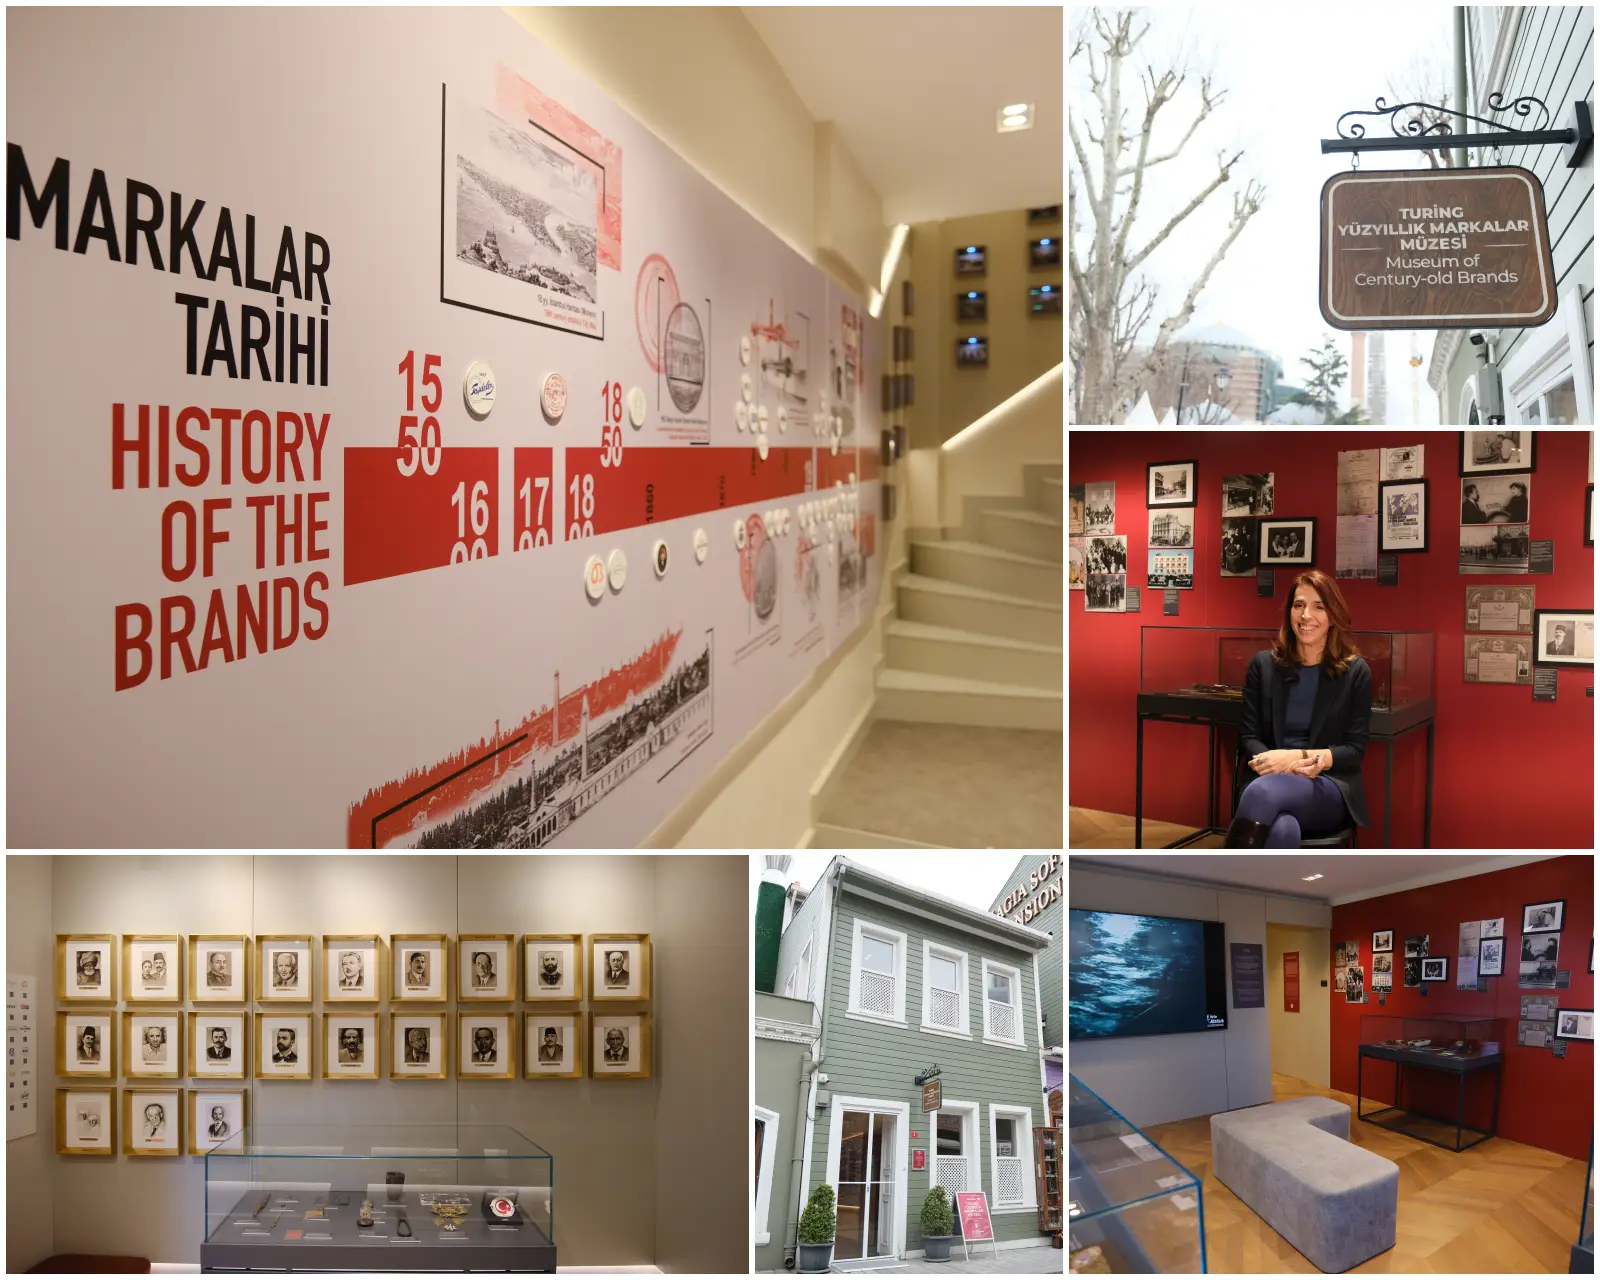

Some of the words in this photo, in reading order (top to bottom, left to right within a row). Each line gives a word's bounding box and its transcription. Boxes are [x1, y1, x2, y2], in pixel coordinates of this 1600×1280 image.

[6, 141, 331, 305] MARKALAR
[1337, 222, 1425, 237] YÜZYILLIK
[1430, 219, 1529, 235] MARKALAR
[1399, 205, 1464, 220] TURİNG
[1386, 256, 1460, 269] Museum
[1464, 254, 1481, 268] of
[1400, 234, 1467, 251] MÜZESİ
[1355, 270, 1453, 288] Century-old
[1458, 269, 1518, 284] Brands
[175, 292, 329, 387] TARİHİ
[398, 350, 442, 413] 15
[601, 381, 622, 423] 18
[112, 403, 331, 490] HISTORY
[397, 415, 441, 477] 50
[600, 426, 622, 468] 50
[451, 480, 490, 538] 16
[519, 477, 550, 528] 17
[569, 474, 595, 521] 18
[161, 498, 232, 583] OF
[246, 491, 330, 571] THE
[115, 570, 330, 692] BRANDS
